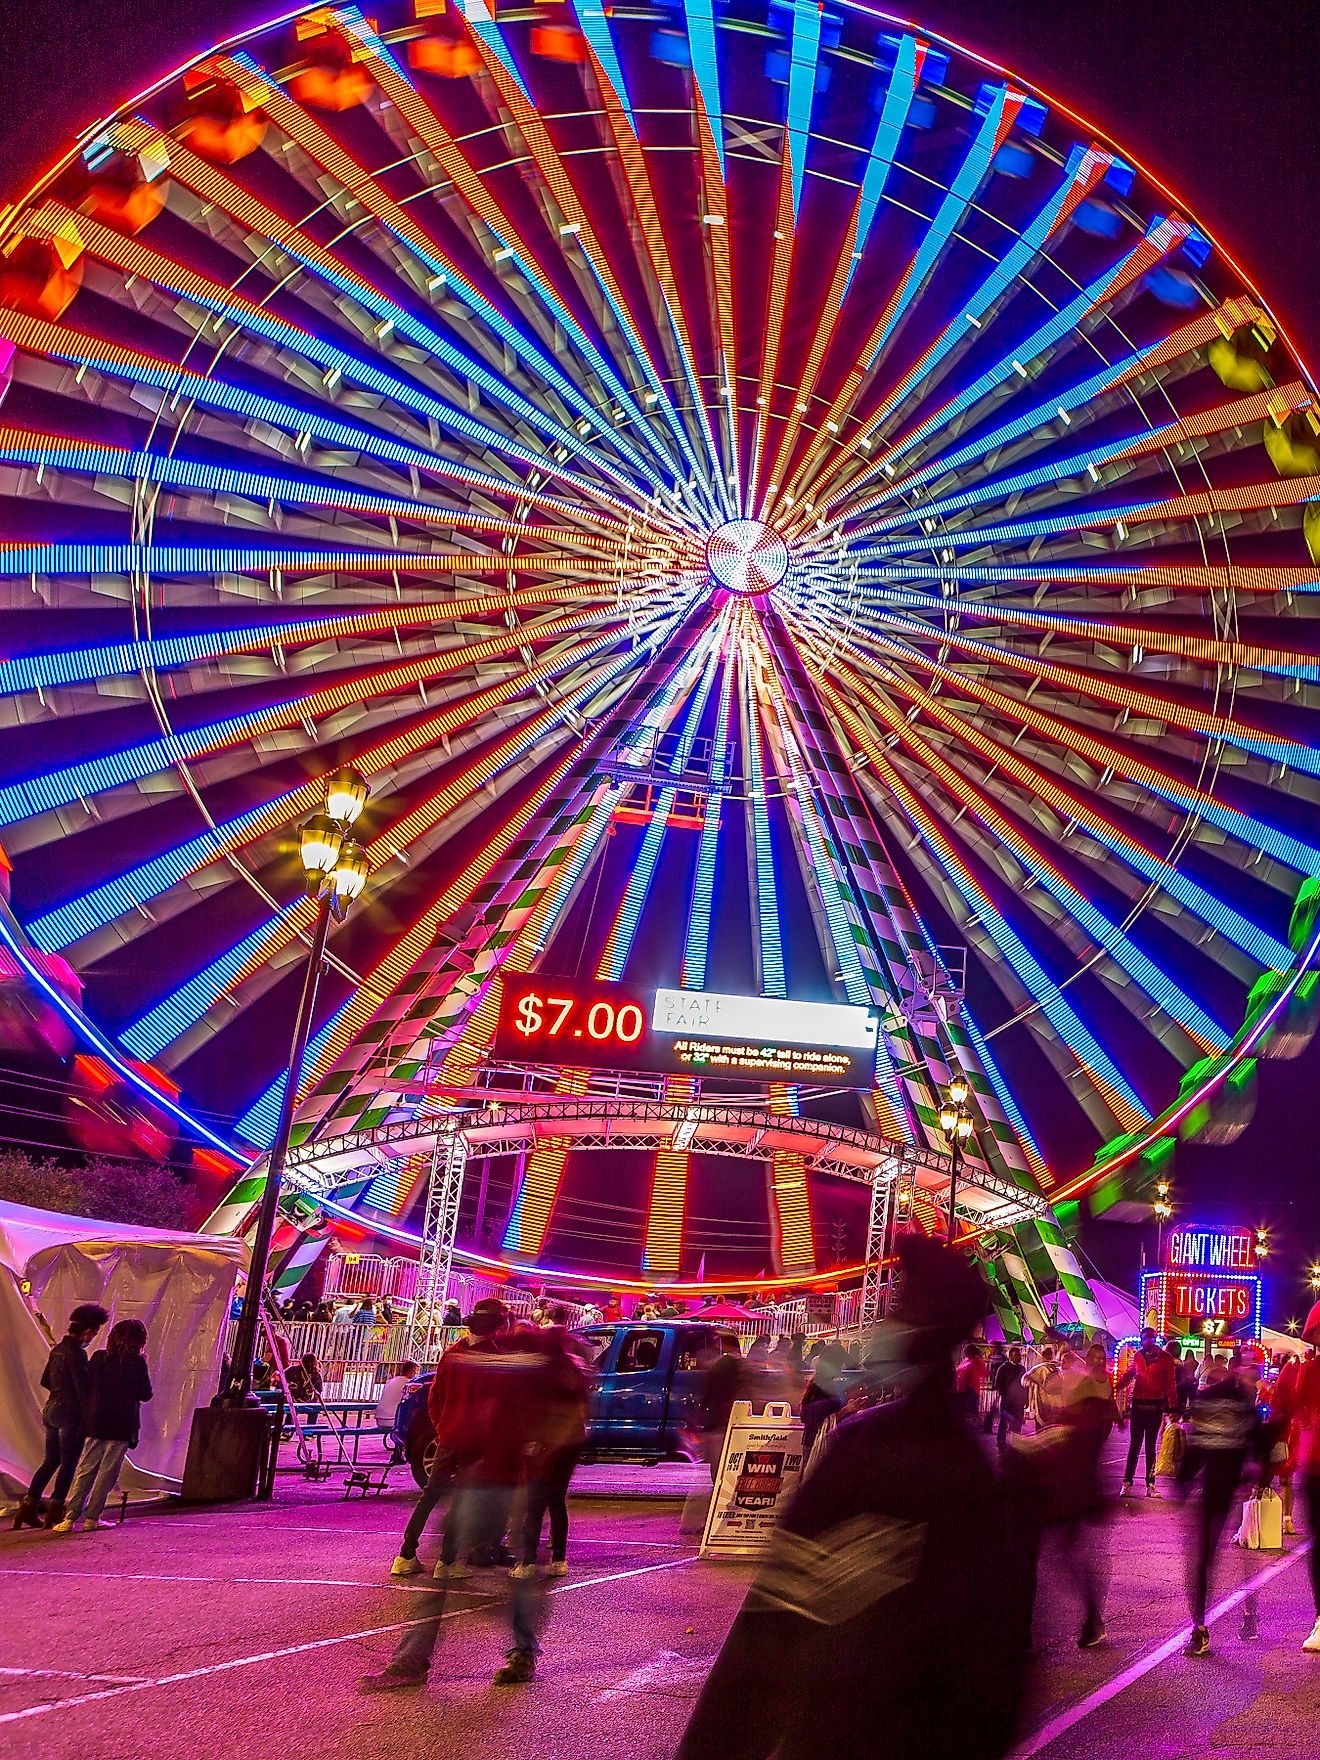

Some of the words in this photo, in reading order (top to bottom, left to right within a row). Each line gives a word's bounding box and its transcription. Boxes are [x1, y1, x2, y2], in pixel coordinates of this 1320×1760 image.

[665, 996, 722, 1014] STATE
[515, 992, 643, 1042] $7.00
[666, 1012, 710, 1027] FAIR
[674, 1041, 688, 1051] All
[689, 1042, 721, 1054] Riders
[722, 1046, 745, 1056] must
[746, 1046, 759, 1057] be
[760, 1048, 776, 1058] 42"
[777, 1049, 791, 1060] tall
[792, 1051, 802, 1060] to
[803, 1052, 821, 1062] ride
[823, 1053, 851, 1065] alone,
[681, 1053, 692, 1061] or
[693, 1052, 710, 1063] 32"
[711, 1054, 729, 1064] with
[739, 1057, 791, 1070] supervising
[793, 1062, 845, 1074] companion.
[1171, 1232, 1209, 1266] GIANT
[1210, 1234, 1254, 1268] WHEEL
[1177, 1285, 1248, 1316] TICKETS
[1203, 1319, 1226, 1336] $7
[1182, 1338, 1200, 1347] OPEN
[749, 1433, 788, 1443] Smithfield
[728, 1452, 744, 1465] OCT
[785, 1454, 802, 1466] TWO
[747, 1463, 777, 1474] WIN
[737, 1496, 775, 1506] YEAR!
